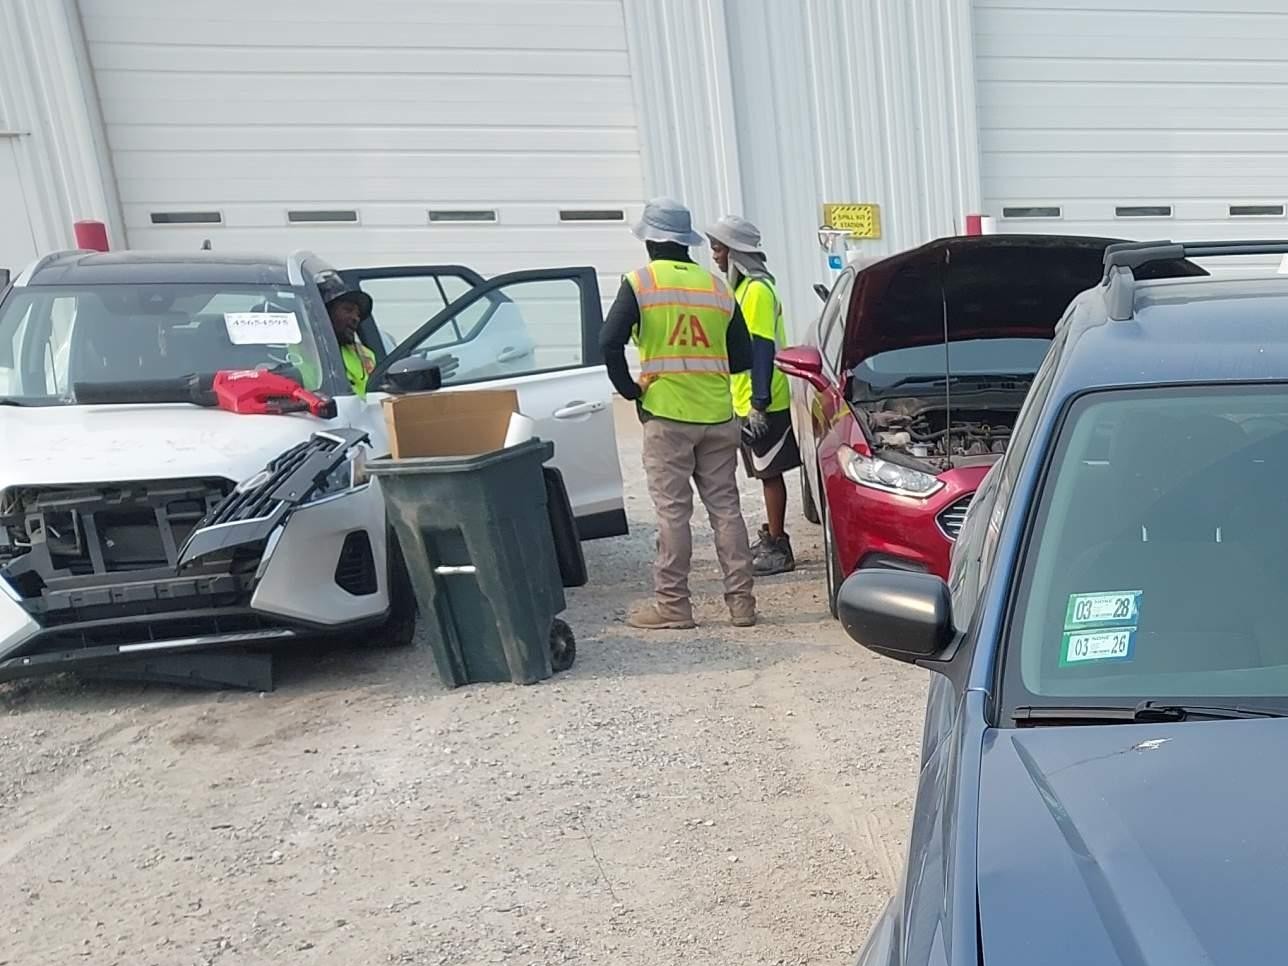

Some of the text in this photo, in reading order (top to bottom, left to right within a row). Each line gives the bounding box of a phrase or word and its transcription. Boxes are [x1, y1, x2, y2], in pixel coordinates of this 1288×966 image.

[1076, 600, 1092, 620] 03
[1113, 598, 1130, 618] 28
[1075, 638, 1089, 656] 03
[1111, 634, 1126, 654] 26
